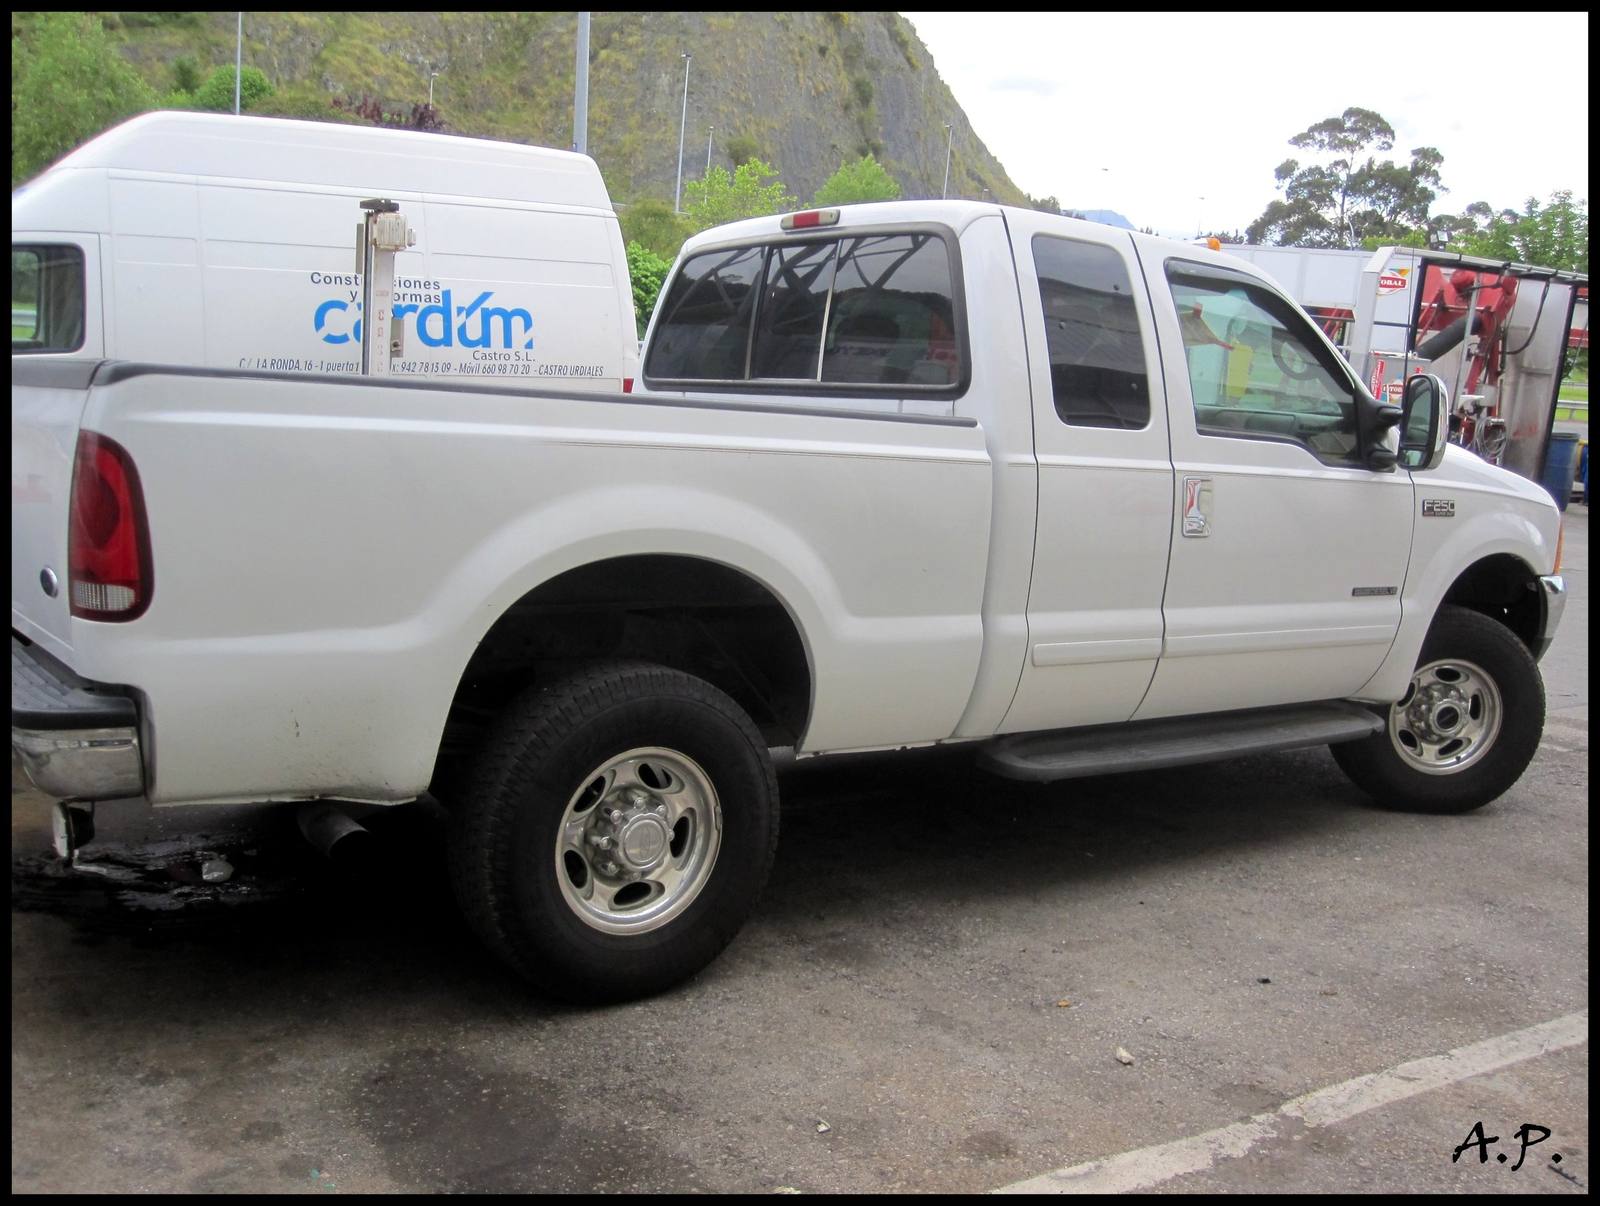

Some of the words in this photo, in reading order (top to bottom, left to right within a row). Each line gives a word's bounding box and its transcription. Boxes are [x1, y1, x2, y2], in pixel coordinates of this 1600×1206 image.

[310, 272, 440, 290] Constiones
[1380, 279, 1404, 287] OBAL
[350, 290, 358, 302] y
[393, 292, 440, 304] ormas
[472, 350, 511, 361] Castro
[514, 351, 536, 362] S.L.
[401, 361, 416, 373] 942
[420, 361, 430, 373] 78
[441, 362, 451, 373] 09
[458, 361, 480, 374] Móvil
[481, 363, 496, 374] 660
[498, 363, 507, 375] 98
[510, 364, 519, 375] 70
[520, 364, 530, 375] 20
[538, 364, 568, 376] CASTRO
[569, 365, 604, 377] URDIALES
